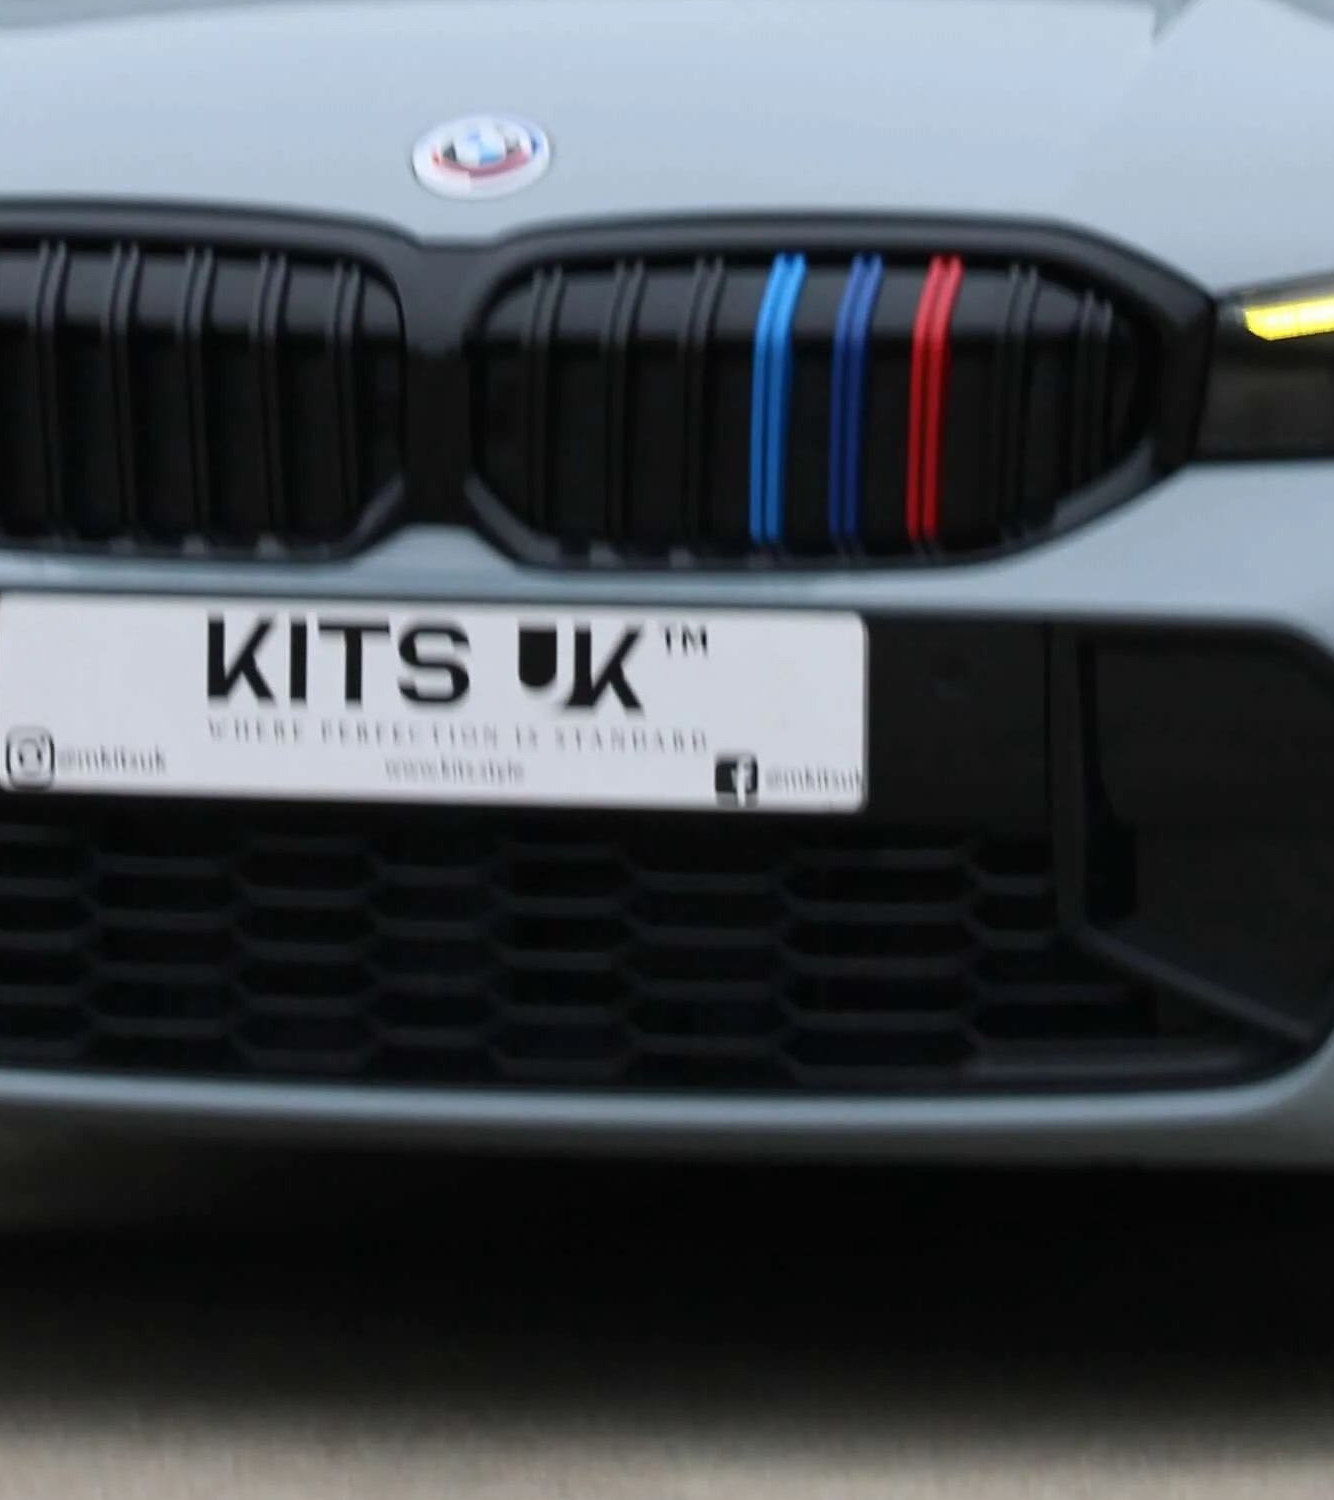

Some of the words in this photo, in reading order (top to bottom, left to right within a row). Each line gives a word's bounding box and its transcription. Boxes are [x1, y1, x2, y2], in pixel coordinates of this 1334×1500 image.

[205, 614, 471, 706] KITS
[208, 717, 304, 745] WHERE
[320, 718, 498, 749] PERFECTION
[553, 724, 707, 753] STANDARD
